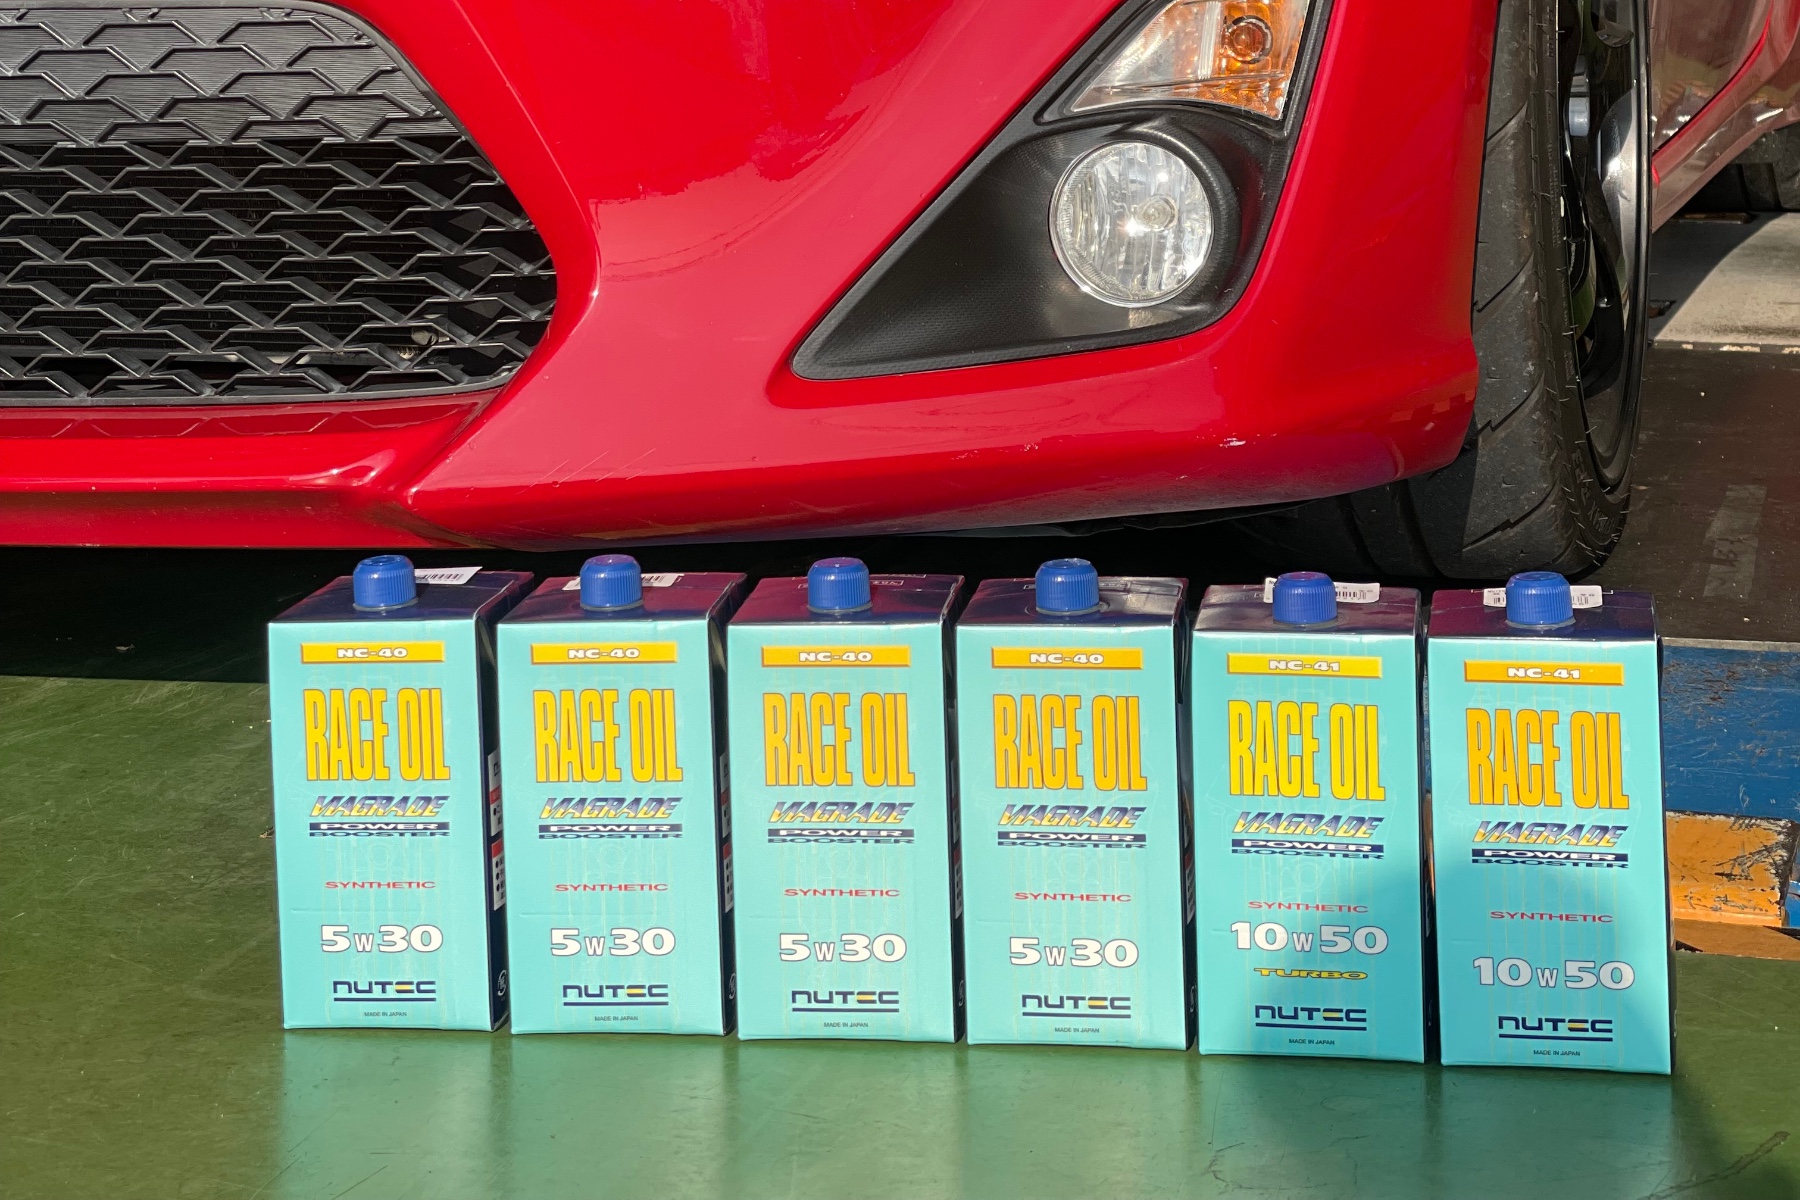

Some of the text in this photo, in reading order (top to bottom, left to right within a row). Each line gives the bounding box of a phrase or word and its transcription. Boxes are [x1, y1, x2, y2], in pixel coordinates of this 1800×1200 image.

[337, 648, 408, 658] NC-40
[568, 648, 640, 659] NC-40
[799, 652, 872, 662] NC-40
[1030, 653, 1104, 664] NC-40
[1269, 659, 1340, 673] NC-41
[1507, 667, 1581, 679] NC-41
[304, 688, 450, 781] RACE OIL
[534, 688, 684, 783] RACE OIL
[763, 692, 915, 787] RACE OIL
[993, 694, 1148, 791] RACE OIL
[1227, 700, 1386, 801] RACE OIL
[1466, 708, 1629, 809] RACE OIL
[310, 795, 450, 818] VIAGRADE
[539, 797, 683, 820] VIAGRADE
[769, 801, 915, 824] VIAGRADE
[999, 804, 1147, 829] VIAGRADE
[320, 823, 439, 831] POWER
[1233, 812, 1385, 839] VIAGRADE
[778, 829, 903, 837] POWER
[1009, 833, 1134, 841] POWER
[1473, 821, 1629, 847] VIAGRADE
[998, 841, 1147, 849] BOOSTER
[1243, 841, 1373, 852] POWER
[1231, 849, 1384, 860] BOOSTER
[1484, 850, 1615, 861] POWER
[1472, 859, 1629, 868] BOOSTER
[325, 881, 436, 889] SYNTHETIC
[785, 889, 900, 897] SYNTHETIC
[1015, 892, 1132, 902] SYNTHETIC
[1249, 901, 1368, 913] SYNTHETIC
[1490, 911, 1613, 923] SYNTHETIC
[1254, 967, 1368, 980] TURBO
[334, 981, 436, 994] NUTEC
[563, 984, 668, 998] NUTEC
[792, 990, 899, 1004] NUTEC
[1022, 994, 1131, 1010] NUTEC
[1255, 1005, 1367, 1023] NUTEC
[1499, 1016, 1613, 1034] NUTEC
